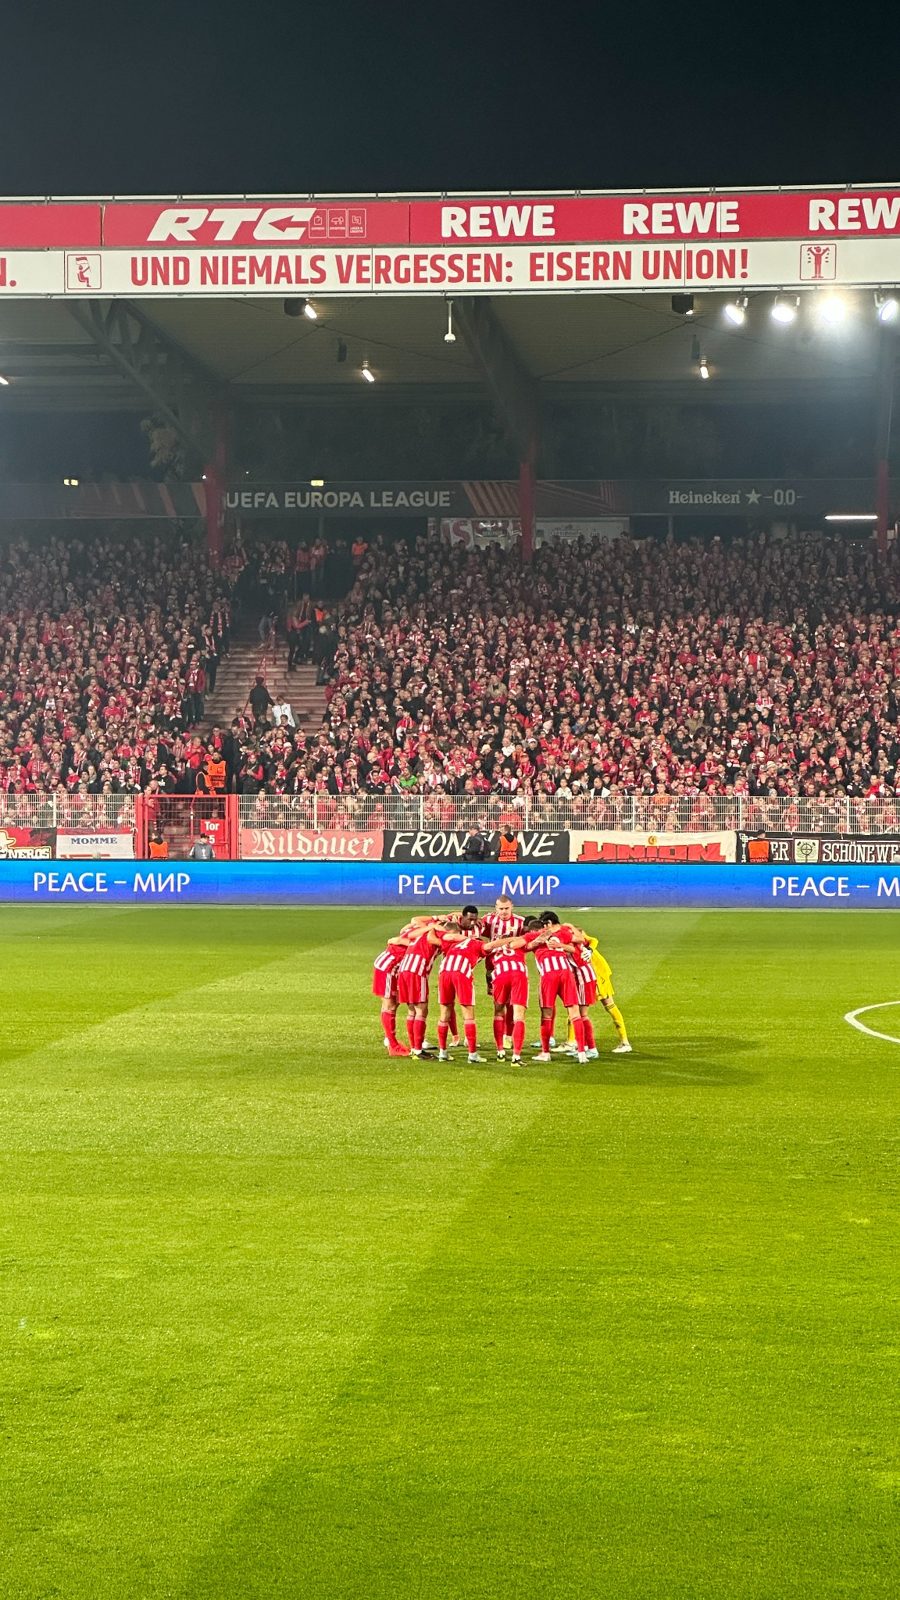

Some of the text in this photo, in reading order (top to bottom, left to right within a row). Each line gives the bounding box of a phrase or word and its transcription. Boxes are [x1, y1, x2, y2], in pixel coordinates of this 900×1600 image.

[441, 205, 556, 238] REWE
[623, 201, 740, 235] REWE
[808, 197, 900, 231] REW
[131, 248, 749, 286] UND NIEMALS VERGESSEN: EISERN UNION!
[226, 490, 451, 509] UEFA EUROPA LEAGUE
[668, 489, 741, 504] Heineken
[204, 821, 220, 831] Tor
[71, 837, 118, 845] MOMME
[209, 834, 216, 844] 5
[251, 831, 375, 857] Wildauer
[33, 872, 108, 892] PEACE
[133, 872, 191, 892] МИР
[398, 875, 475, 895] PEACE
[501, 875, 560, 896] МИР
[772, 876, 851, 897] PEACE
